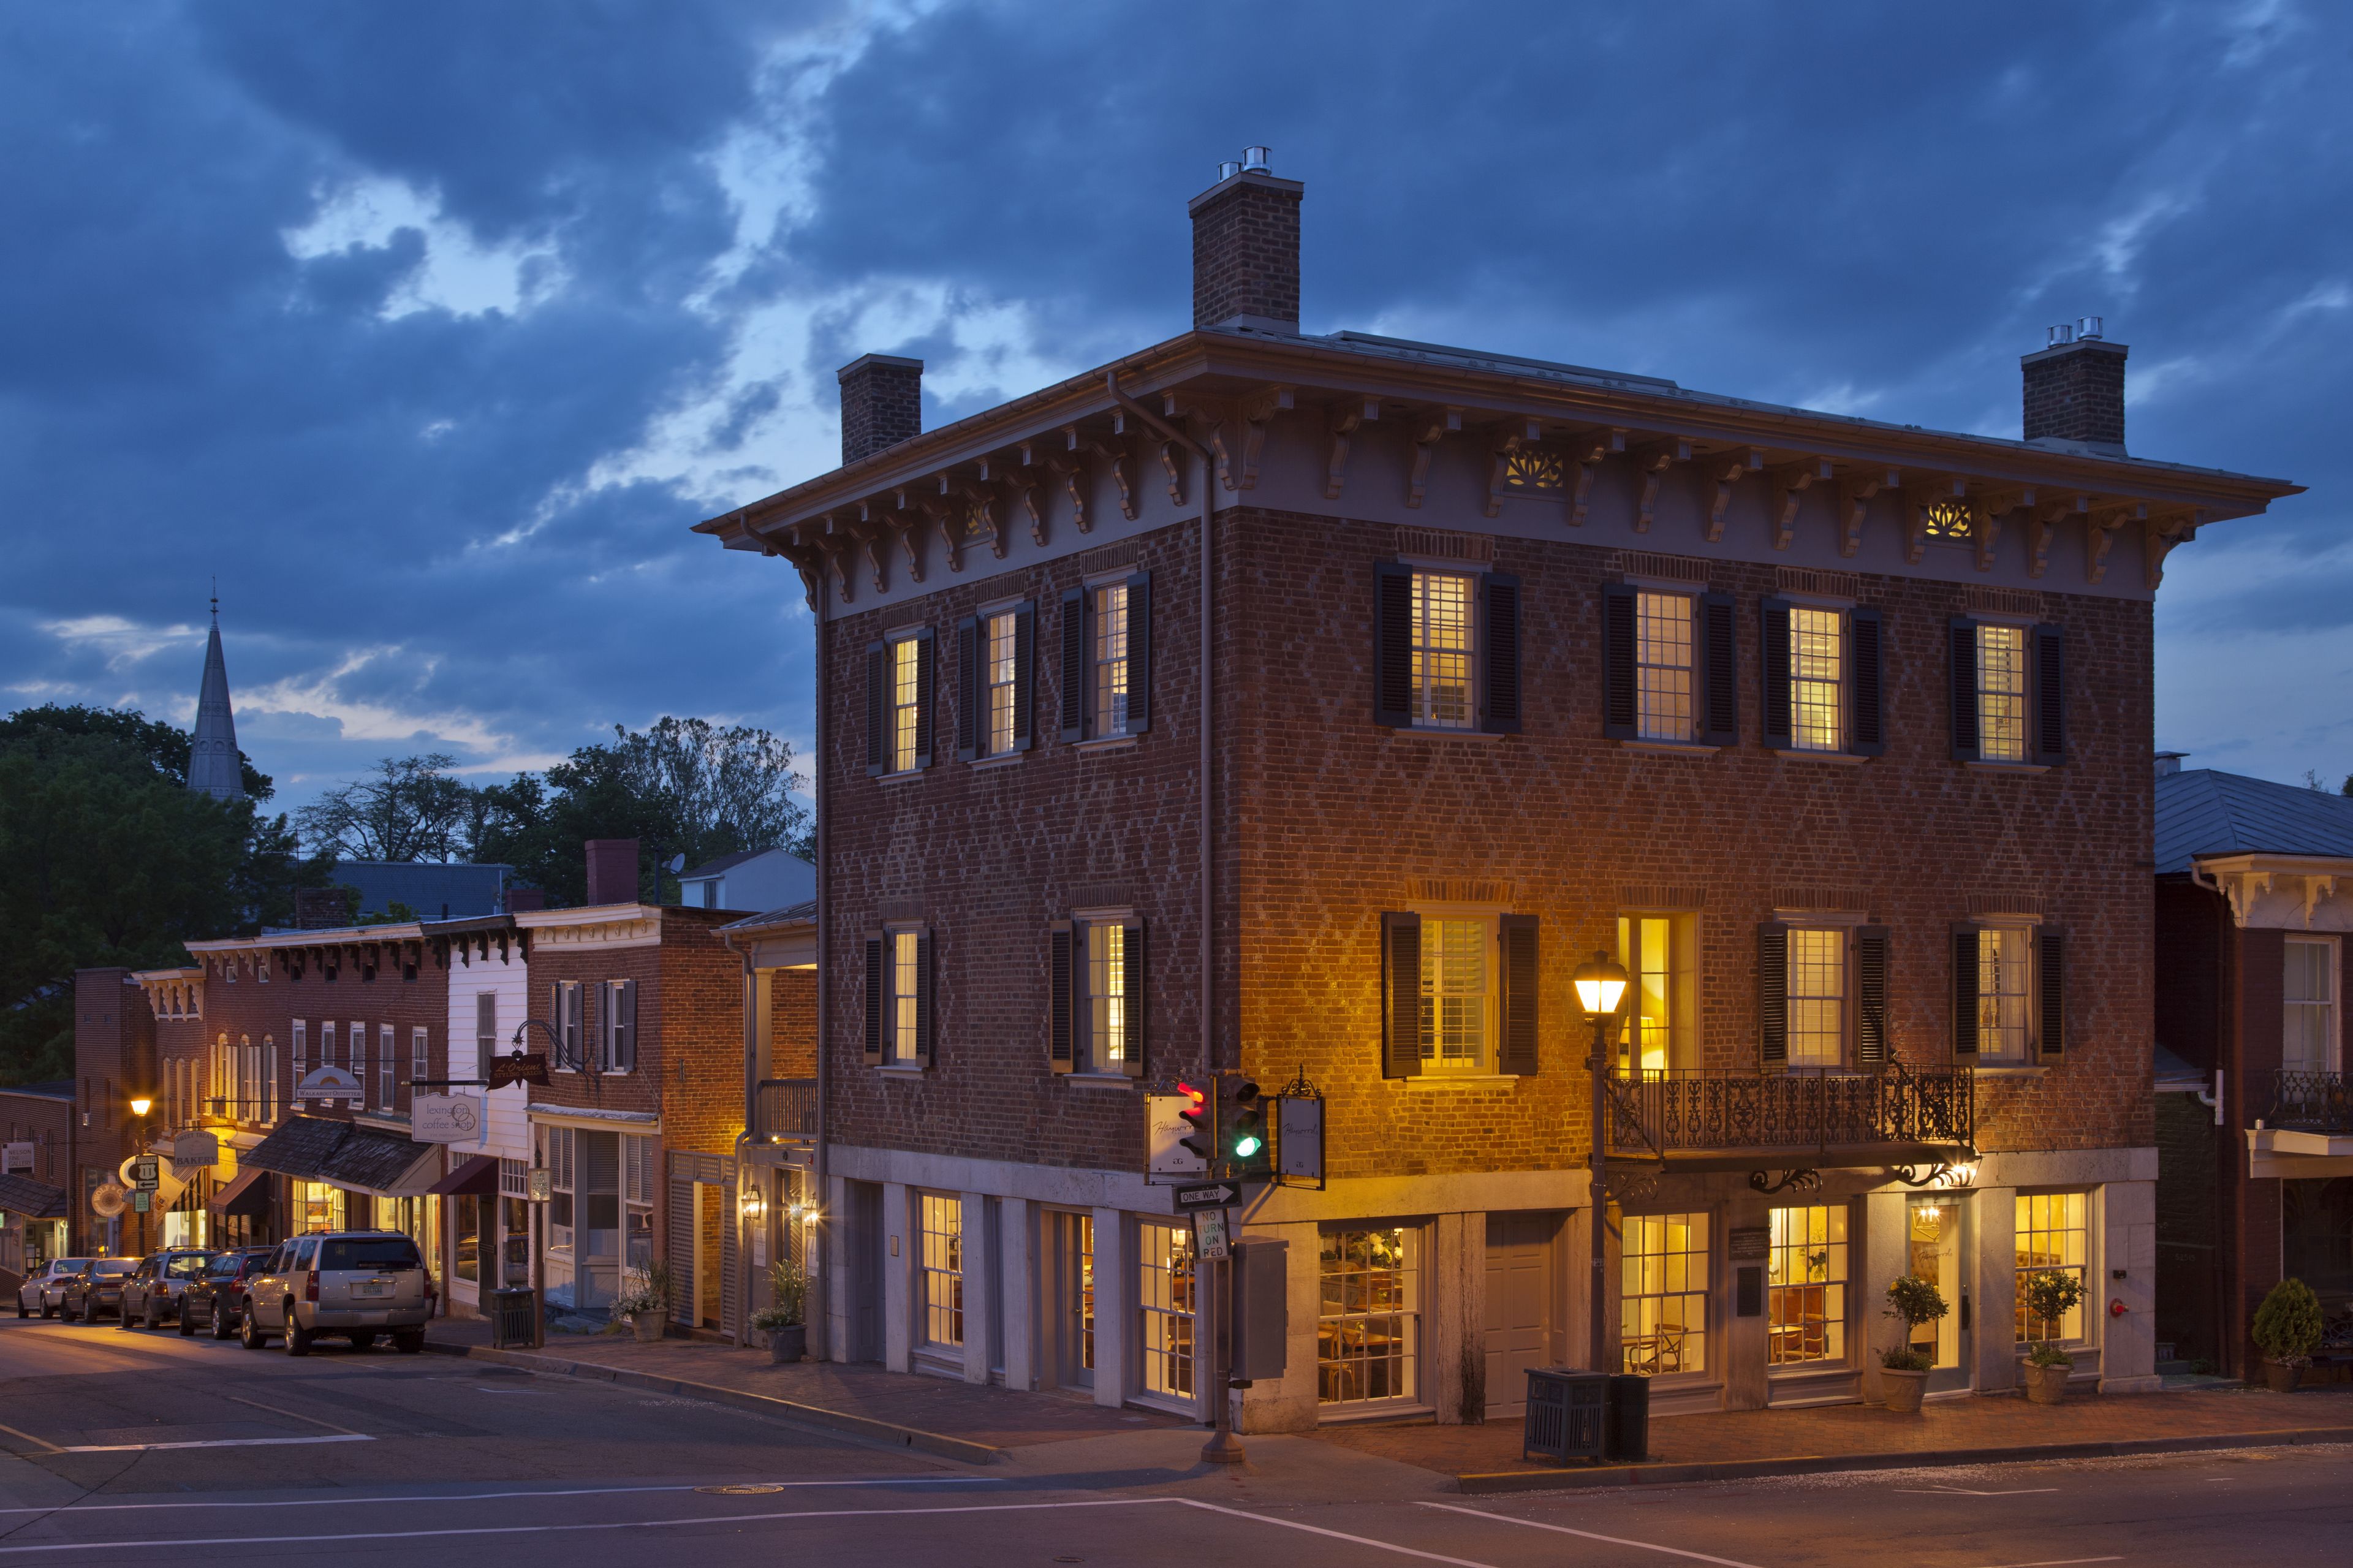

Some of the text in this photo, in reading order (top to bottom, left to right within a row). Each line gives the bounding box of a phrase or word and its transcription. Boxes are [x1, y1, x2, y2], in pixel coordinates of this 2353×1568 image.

[426, 1104, 468, 1117] lexington
[422, 1118, 472, 1131] coffee shop
[176, 1132, 216, 1143] SWEET TREATS
[176, 1156, 216, 1165] BAKERY
[143, 1167, 151, 1176] 11
[93, 1185, 110, 1201] WOLF
[1183, 1190, 1219, 1202] ONE WAY
[1202, 1211, 1216, 1221] NO
[1197, 1222, 1224, 1234] TURN
[1205, 1235, 1219, 1245] ON
[1203, 1247, 1222, 1257] RED
